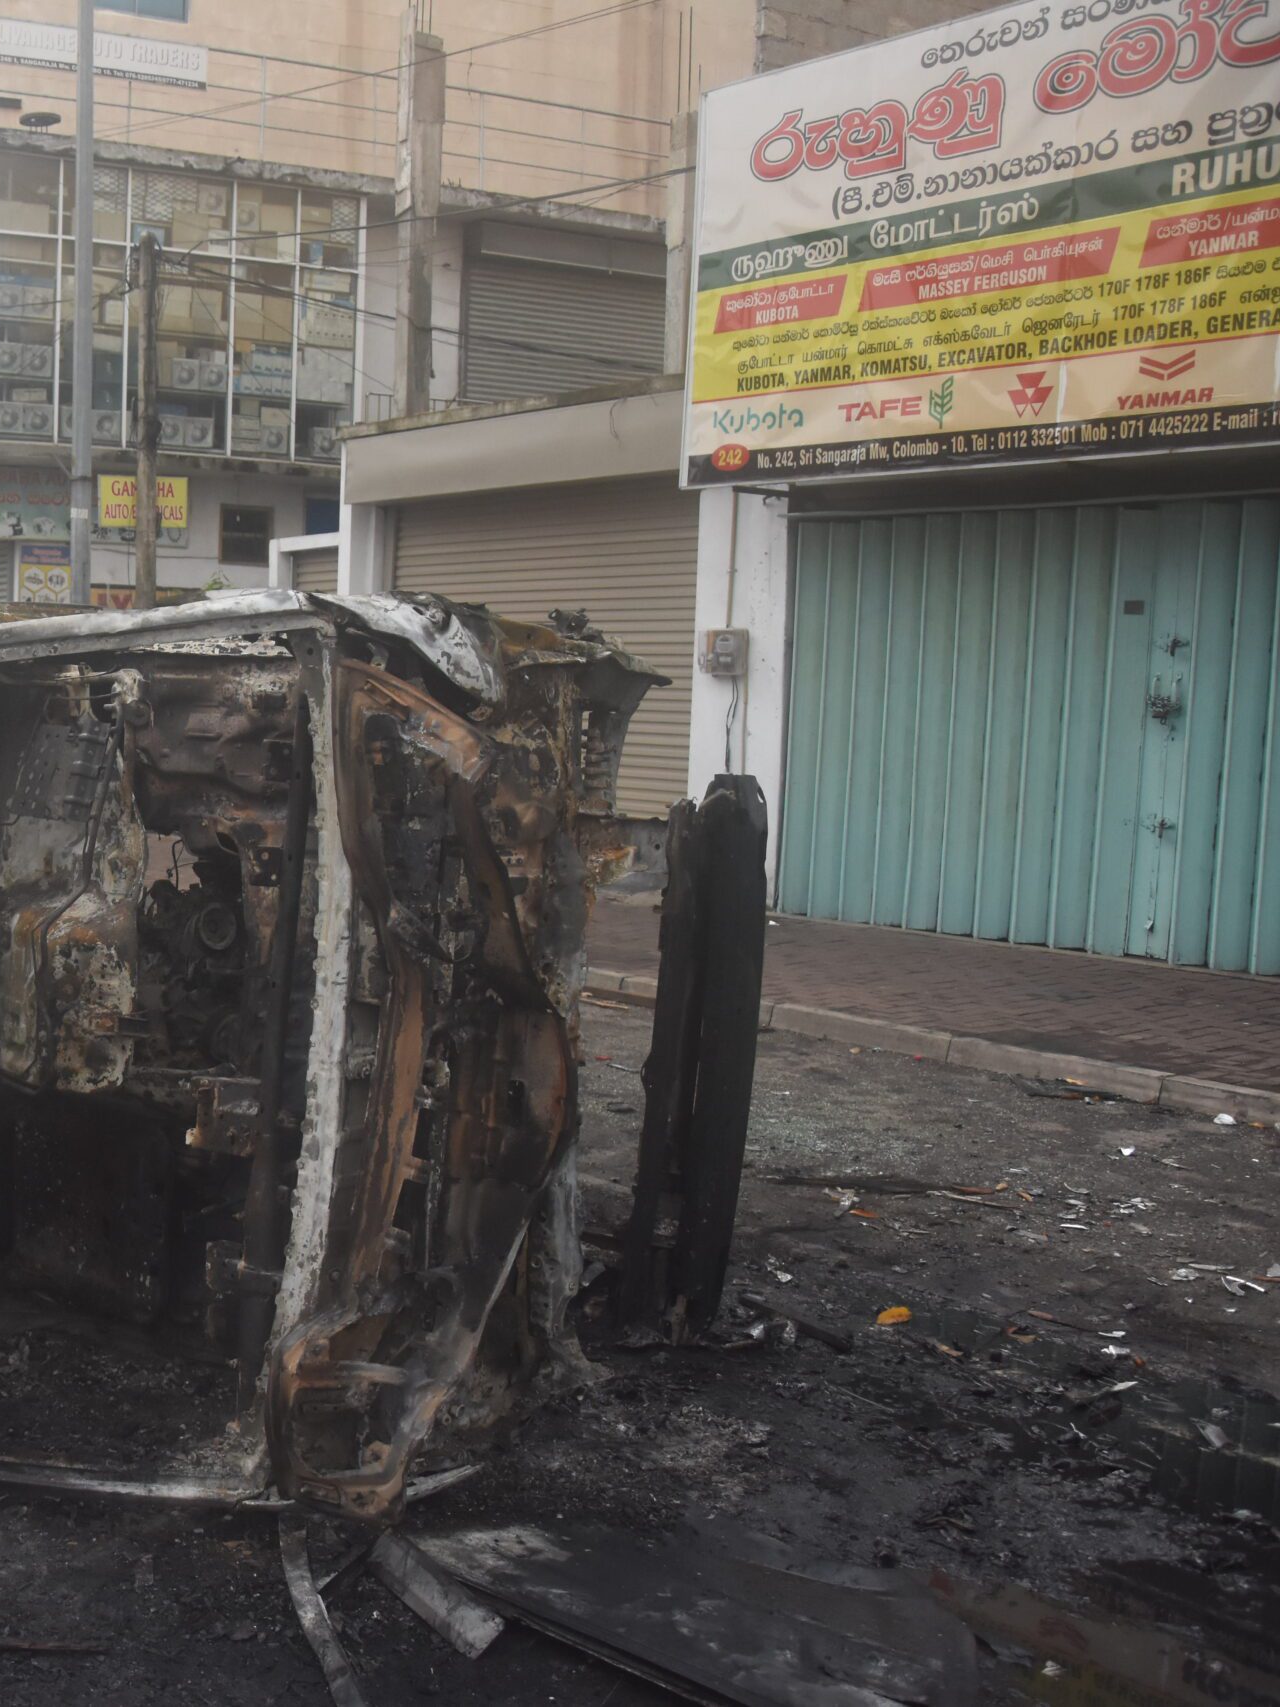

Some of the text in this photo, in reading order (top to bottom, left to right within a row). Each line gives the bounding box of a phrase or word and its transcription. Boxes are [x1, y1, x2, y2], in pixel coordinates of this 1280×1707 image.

[1131, 120, 1193, 153] සහ
[1188, 231, 1259, 257] YANMAR
[919, 265, 1048, 300] MASSEY FERGUSON
[1098, 279, 1131, 298] 170F
[1135, 272, 1170, 293] 178F
[1175, 266, 1212, 286] 186F
[756, 305, 799, 325] KUBOTA
[1112, 301, 1146, 322] 170F
[1151, 296, 1186, 317] 178F
[1191, 291, 1227, 311] 186F
[737, 371, 790, 393] KUBOTA,
[794, 364, 856, 385] YANMAR,
[860, 355, 932, 378] KOMATSU,
[938, 340, 1032, 368] EXCAVATOR,
[1039, 329, 1117, 357] BACKHOE
[1123, 319, 1199, 345] LOADER,
[838, 396, 923, 422] TAFE
[1117, 387, 1214, 411] YANMAR
[713, 403, 804, 435] Kubota
[757, 454, 773, 470] No.
[775, 452, 797, 469] 242,
[800, 450, 813, 465] Sri
[815, 446, 866, 467] Sangaraja
[869, 443, 890, 460] Mw,
[893, 439, 939, 457] Colombo
[951, 436, 968, 453] 10.
[998, 431, 1027, 449] 0112
[1031, 426, 1076, 447] 332501
[1081, 423, 1107, 443] Mob
[1120, 419, 1143, 439] 071
[1149, 413, 1209, 436] 4425222
[1213, 408, 1258, 431] E-mail
[718, 448, 743, 467] 242
[104, 504, 130, 520] AUTO
